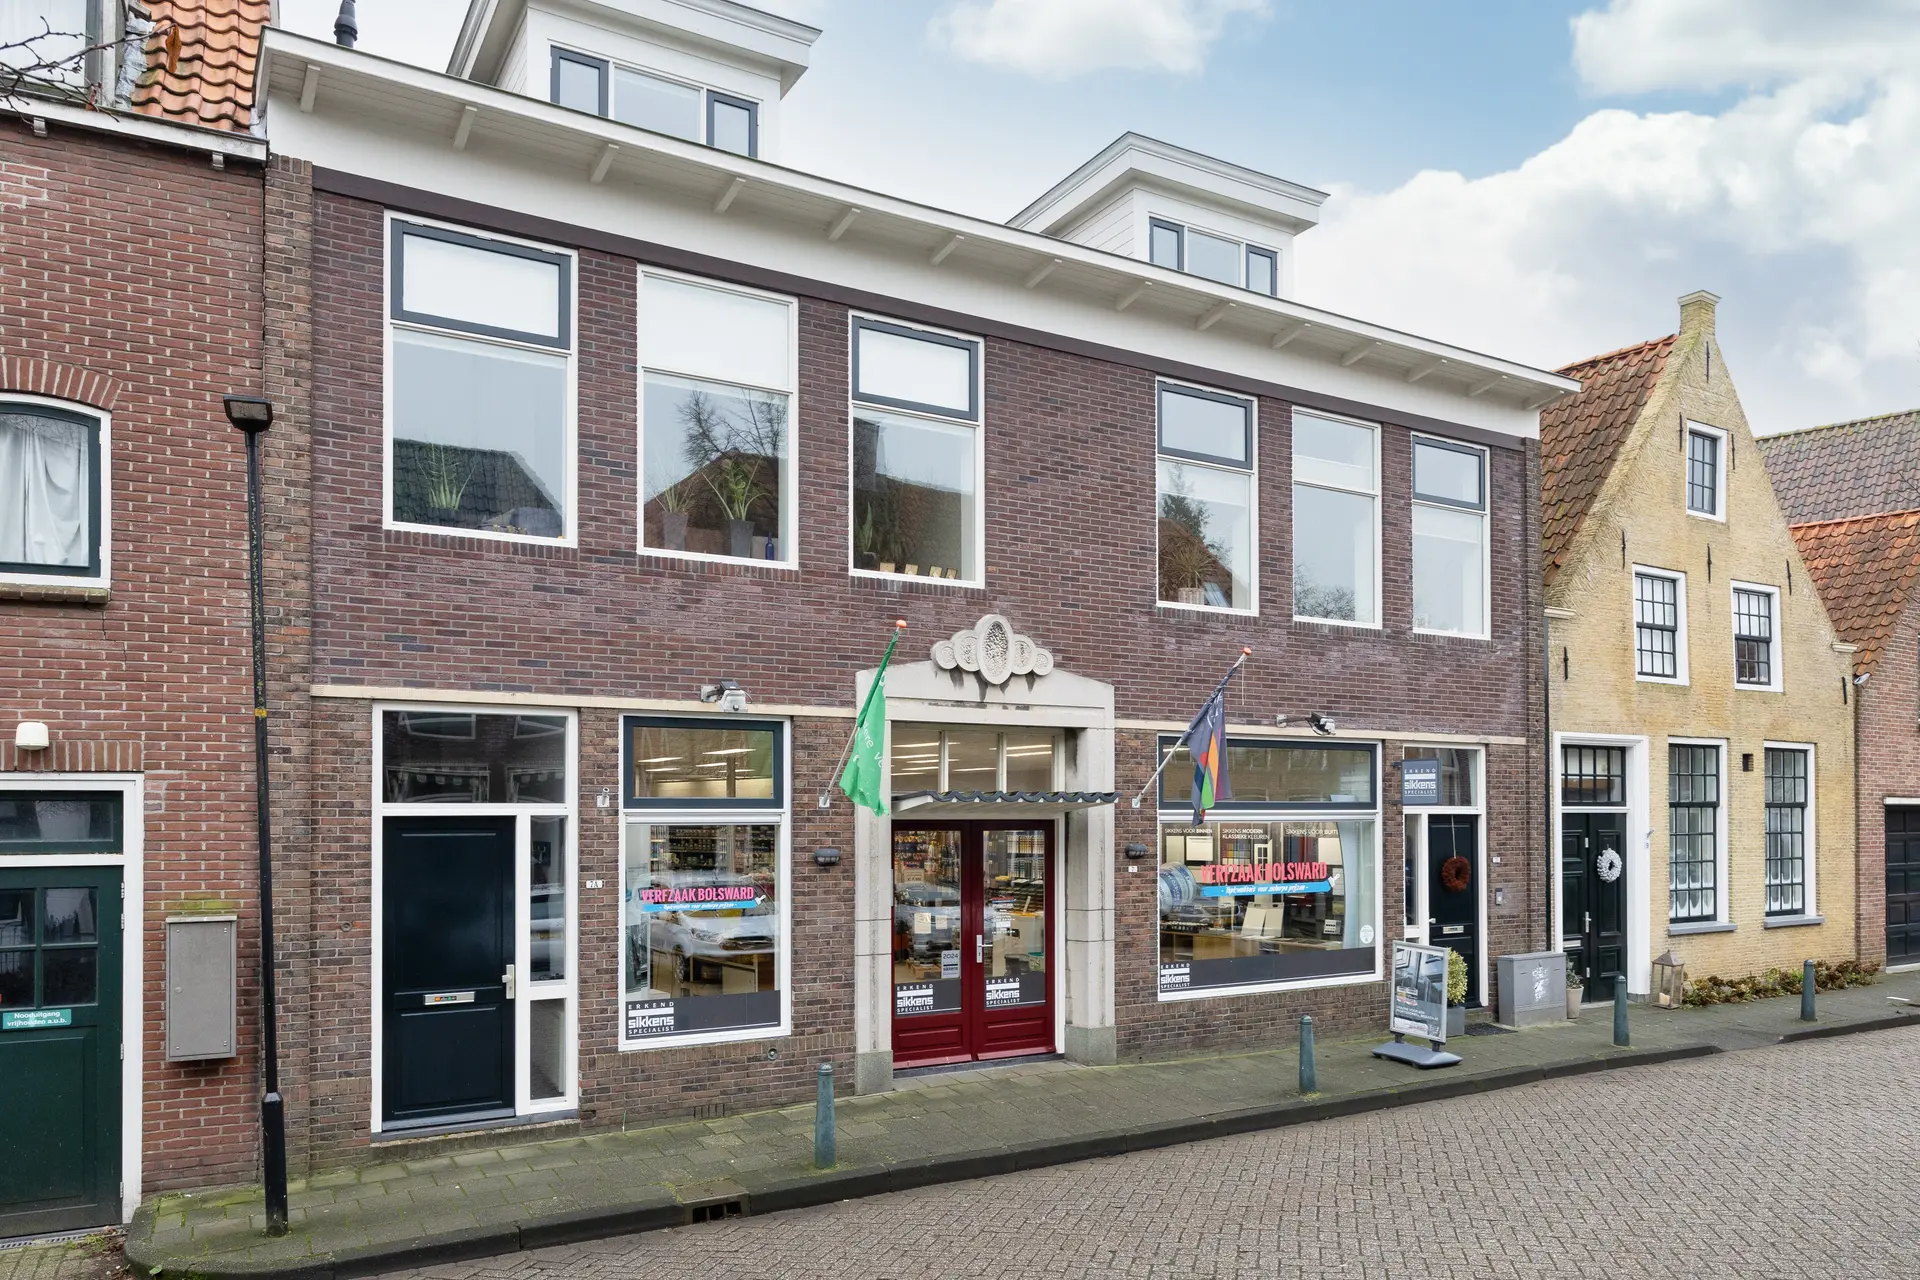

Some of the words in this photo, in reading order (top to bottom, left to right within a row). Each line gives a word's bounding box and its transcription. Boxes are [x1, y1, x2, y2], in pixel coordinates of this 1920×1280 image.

[1404, 780, 1436, 790] sikkens
[1200, 863, 1263, 883] VERFZAAK
[1264, 861, 1327, 881] BOLSWARD
[641, 887, 697, 903] VERFZAAK
[697, 886, 754, 901] BOLSWARD
[986, 977, 1020, 985] ERKEND
[1160, 974, 1190, 984] sikkens
[986, 989, 1020, 1001] sikkens
[628, 1001, 674, 1010] ERKEND
[897, 996, 933, 1008] sikkens
[897, 1005, 933, 1013] SPECIALIST
[14, 1011, 61, 1019] Nooduitgang
[7, 1019, 46, 1027] vrijhouden
[628, 1016, 674, 1029] sikkens
[628, 1025, 675, 1034] SPECIALIST
